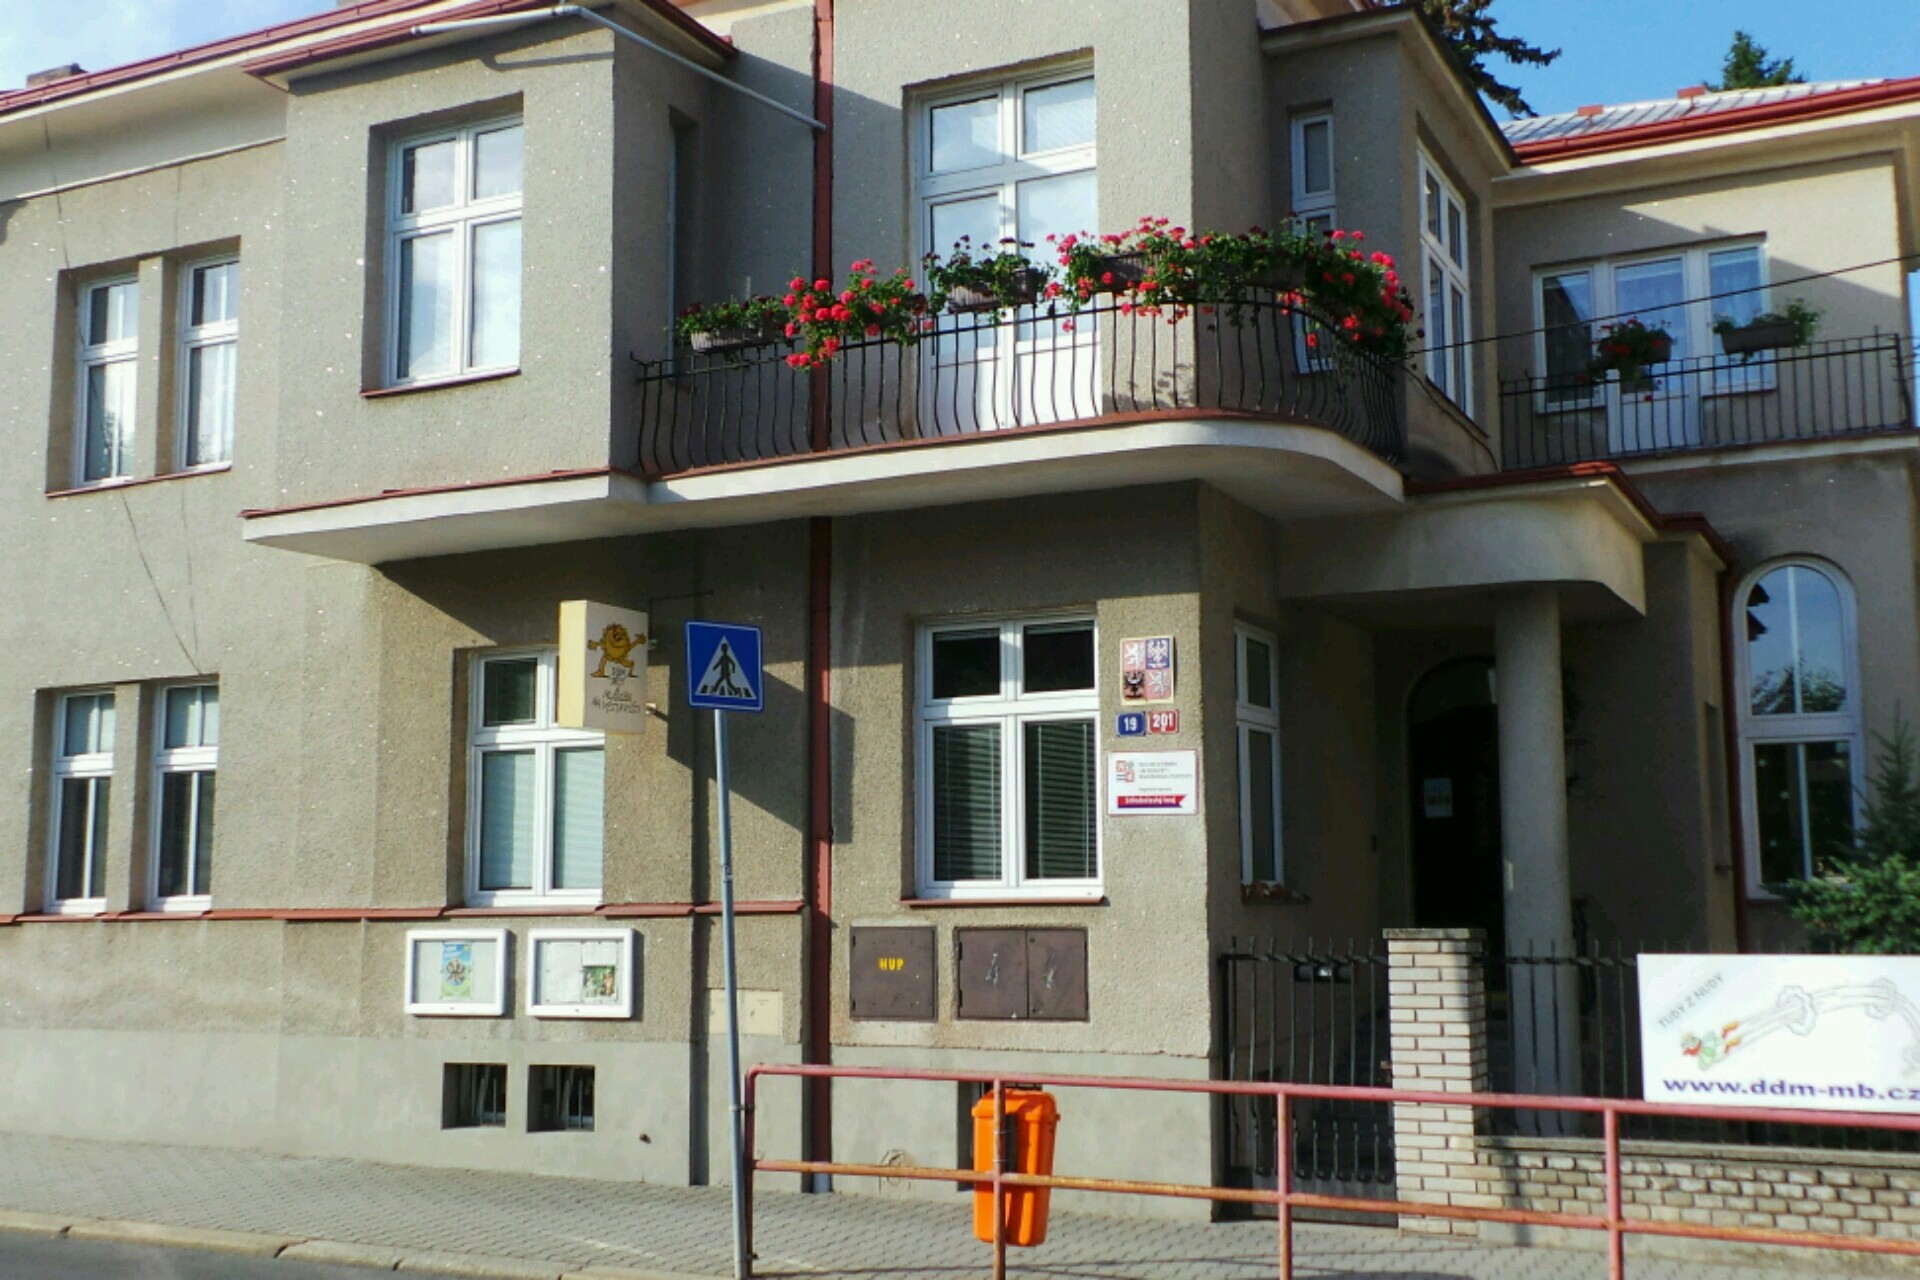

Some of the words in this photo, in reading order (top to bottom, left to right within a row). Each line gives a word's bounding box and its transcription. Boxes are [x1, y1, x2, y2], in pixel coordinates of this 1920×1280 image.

[1123, 717, 1137, 731] 19
[1152, 713, 1173, 730] 201
[878, 958, 904, 971] HUP
[1657, 1003, 1685, 1028] TUDY
[1693, 972, 1725, 1001] NUDY
[1663, 1078, 1920, 1101] www.ddm-mb.cz
